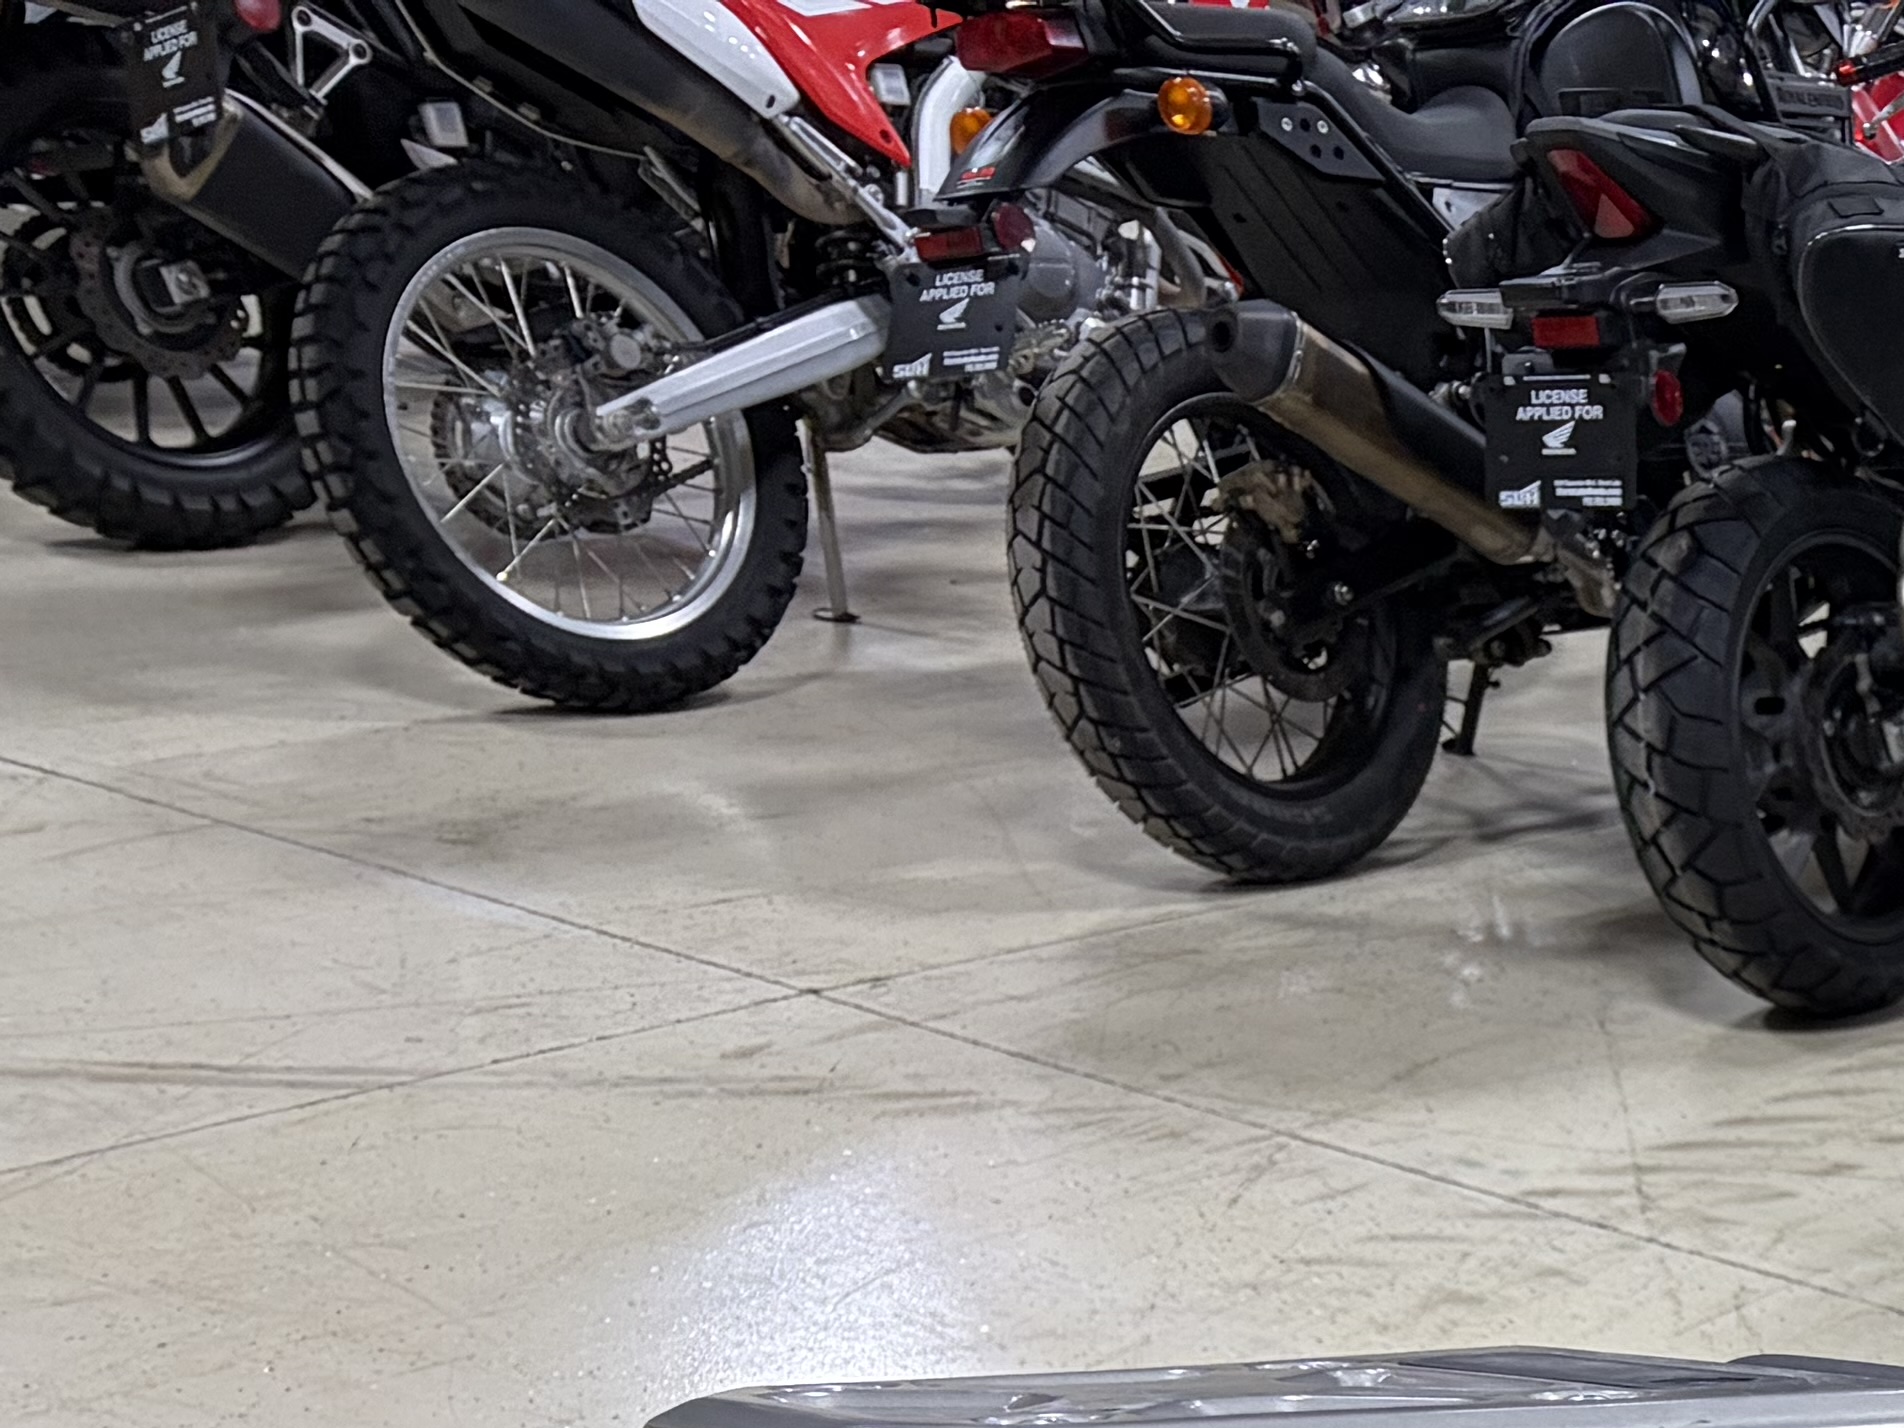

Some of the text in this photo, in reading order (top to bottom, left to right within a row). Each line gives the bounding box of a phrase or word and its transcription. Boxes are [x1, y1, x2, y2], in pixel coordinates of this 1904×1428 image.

[935, 269, 984, 287] LICENSE
[919, 282, 995, 301] APPLIED FOR
[1531, 389, 1588, 404] LICENSE
[1516, 405, 1603, 420] APPLIED FOR
